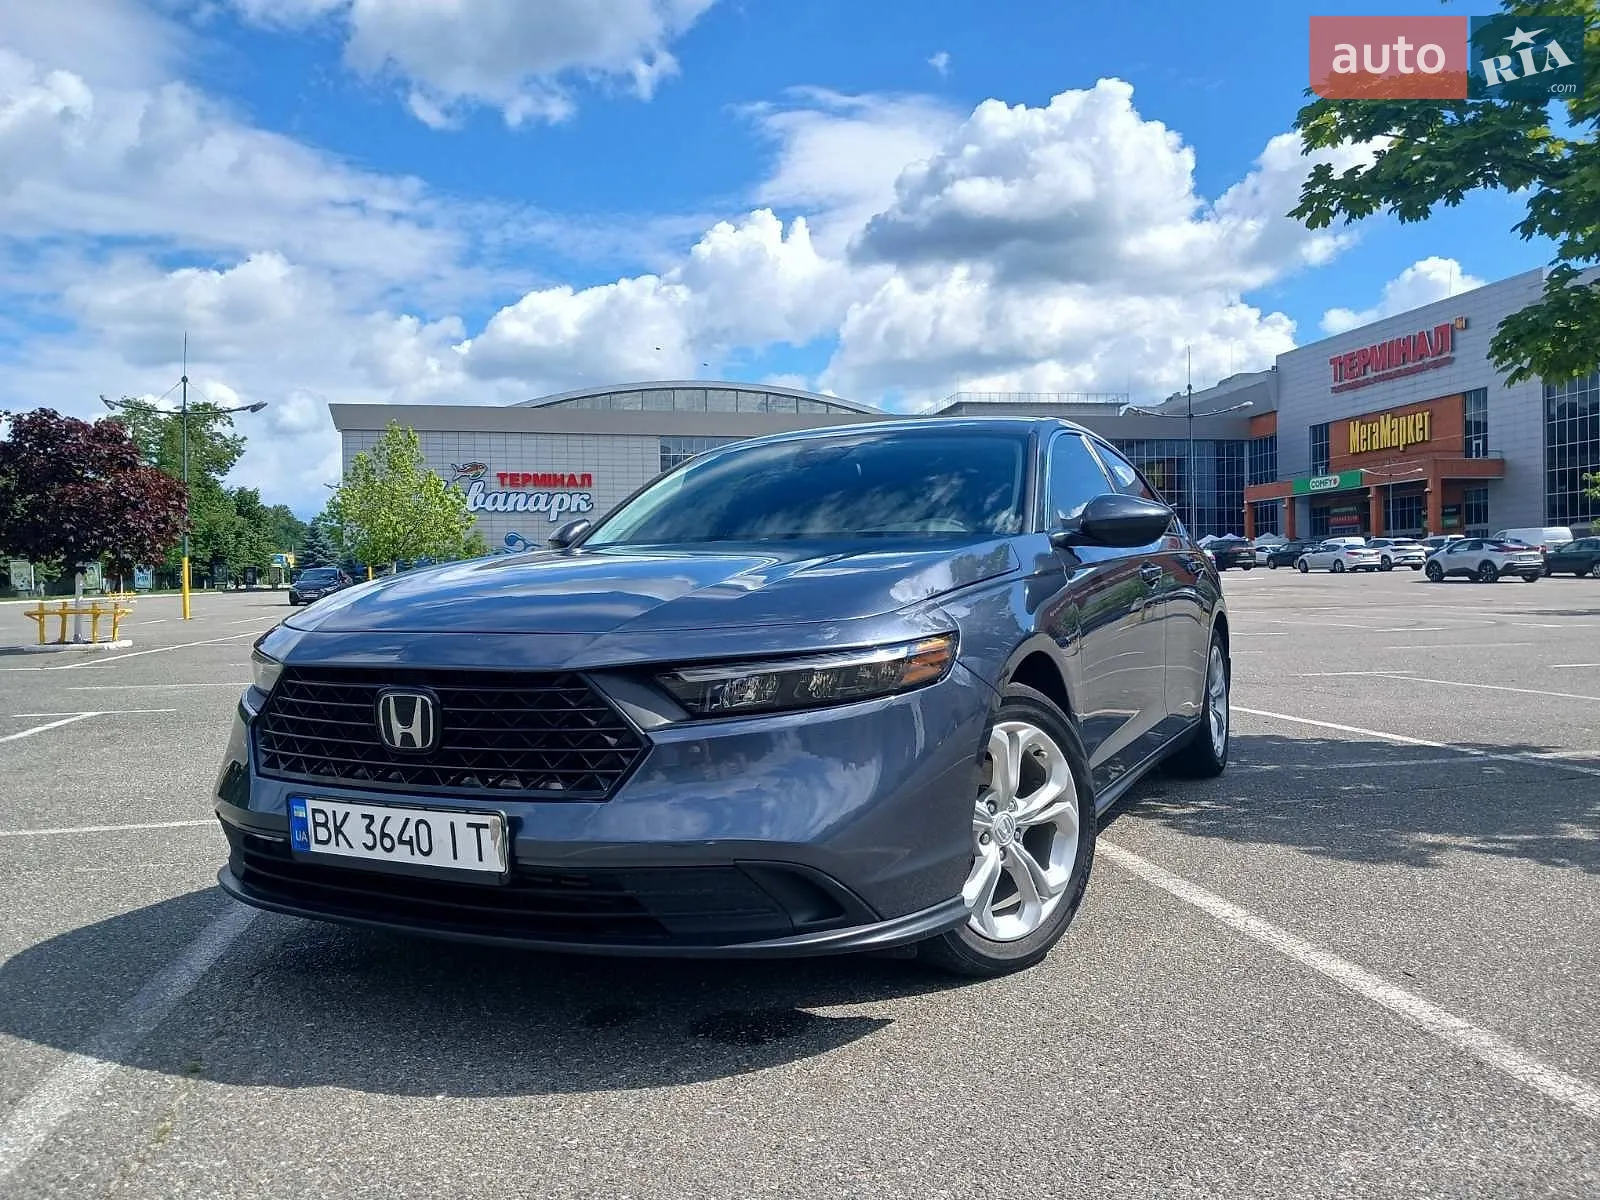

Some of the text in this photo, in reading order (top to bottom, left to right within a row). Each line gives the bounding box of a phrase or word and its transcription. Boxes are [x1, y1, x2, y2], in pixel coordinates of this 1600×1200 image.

[1329, 323, 1453, 384] ТЕРМІНАЛ
[1348, 410, 1431, 454] МегаМаркет
[440, 479, 593, 522] вапарк
[496, 472, 593, 489] ТЕРМІНАЛ
[295, 830, 308, 842] UA
[311, 807, 489, 862] BK 3640 IT
